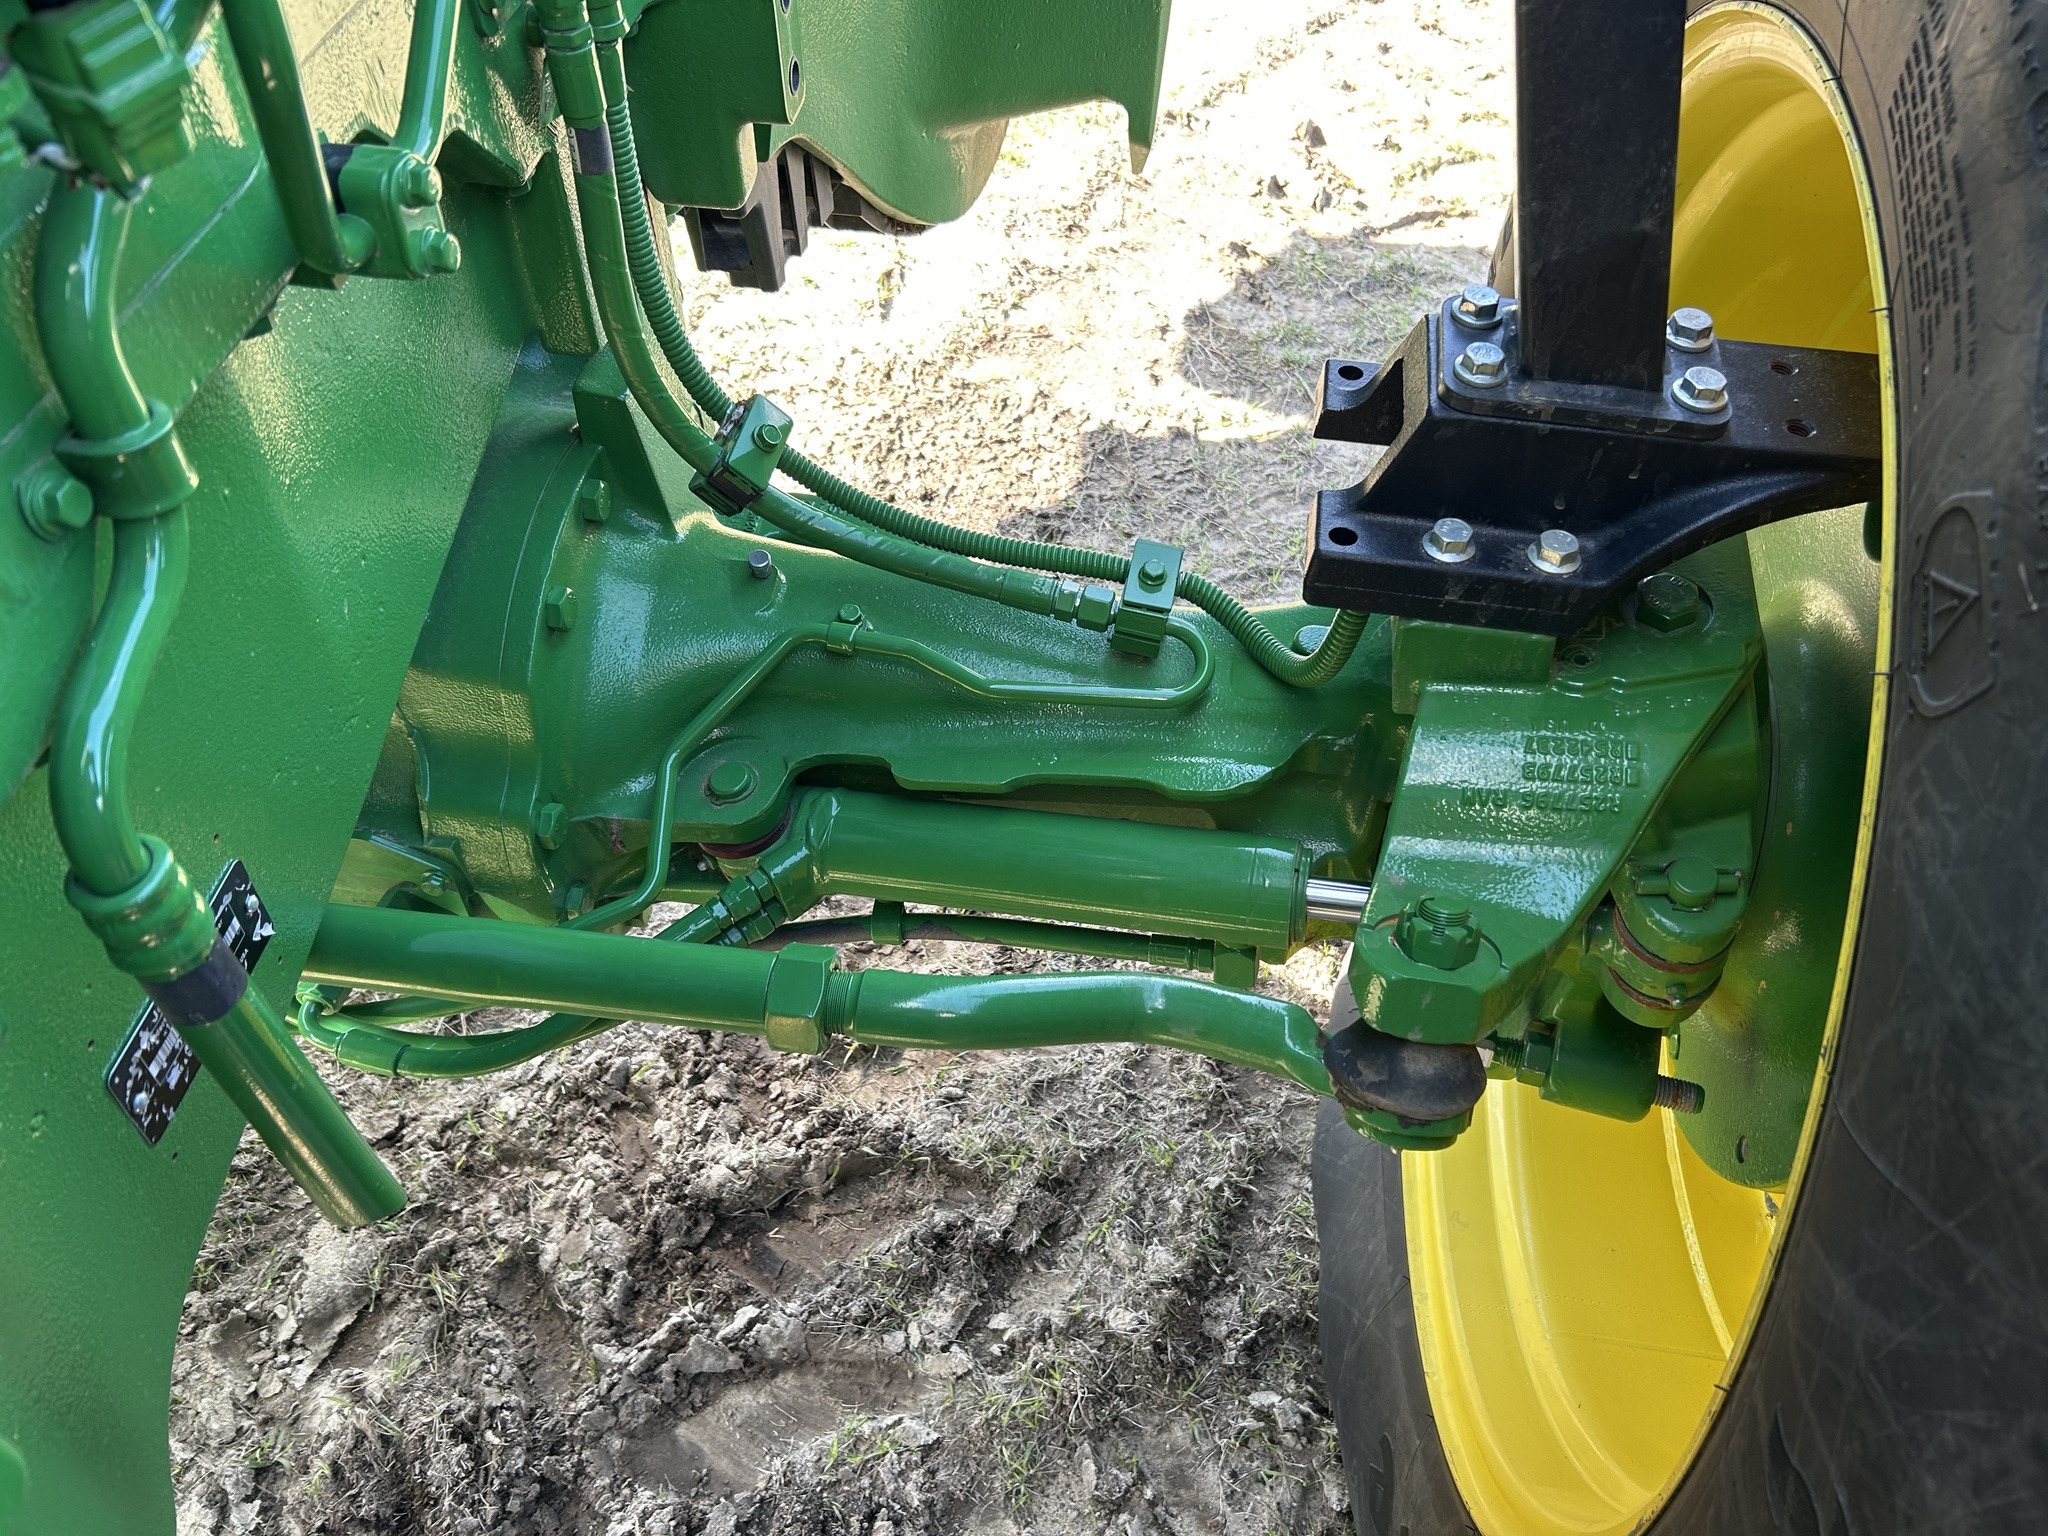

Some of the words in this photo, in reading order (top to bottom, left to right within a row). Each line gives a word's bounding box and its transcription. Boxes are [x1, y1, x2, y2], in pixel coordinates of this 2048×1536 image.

[1523, 736, 1622, 760] R542237
[1461, 787, 1508, 807] RAM
[1521, 790, 1621, 813] R257796
